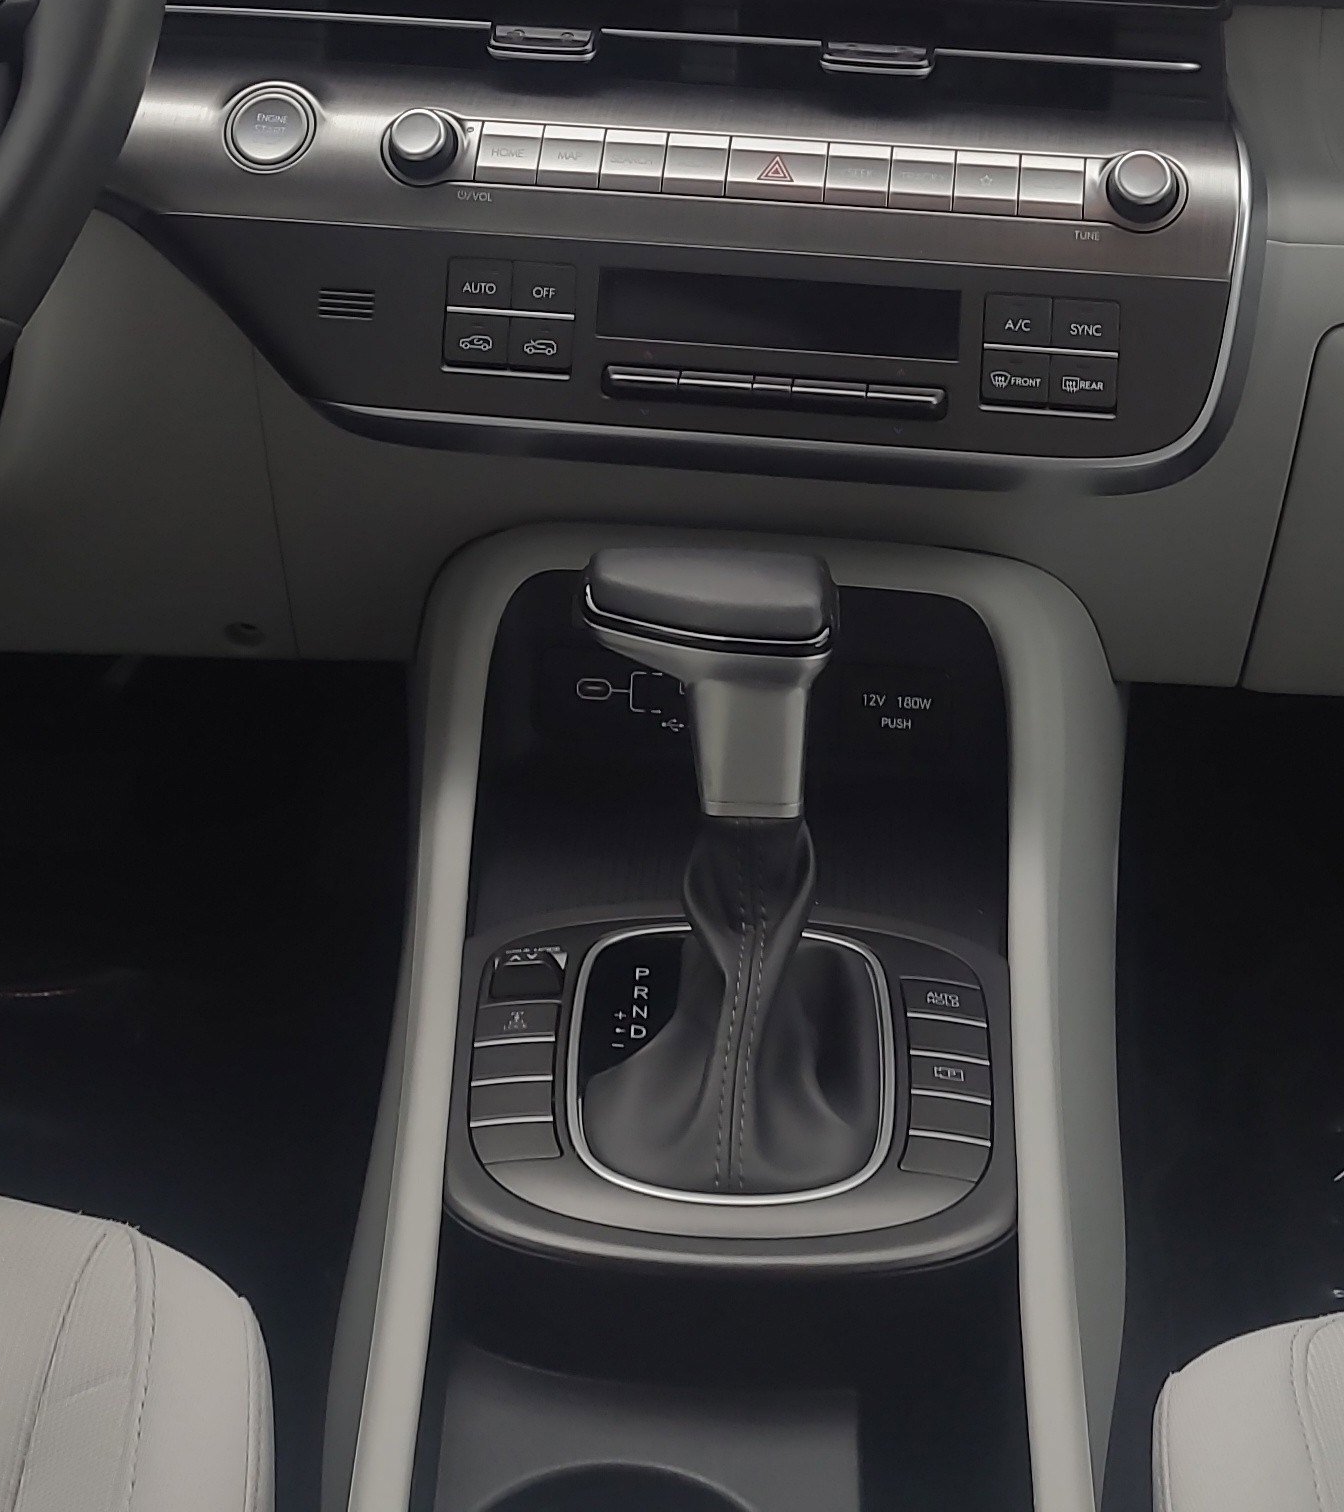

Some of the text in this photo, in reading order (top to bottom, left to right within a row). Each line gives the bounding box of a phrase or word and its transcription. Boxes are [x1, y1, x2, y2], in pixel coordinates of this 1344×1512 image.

[256, 113, 288, 124] ENGINE
[491, 148, 525, 158] HOME
[1074, 230, 1100, 242] TUNE
[462, 281, 497, 295] AUTO
[532, 286, 557, 299] OFF
[1004, 318, 1031, 332] A/C
[1069, 323, 1102, 337] SYNC
[1010, 375, 1042, 388] FRONT
[1079, 379, 1104, 391] REAR
[862, 693, 932, 710] 12V 180W
[881, 717, 912, 730] PUSH
[636, 968, 650, 981] P
[634, 986, 649, 1000] R
[632, 1004, 648, 1019] N
[630, 1023, 647, 1039] D
